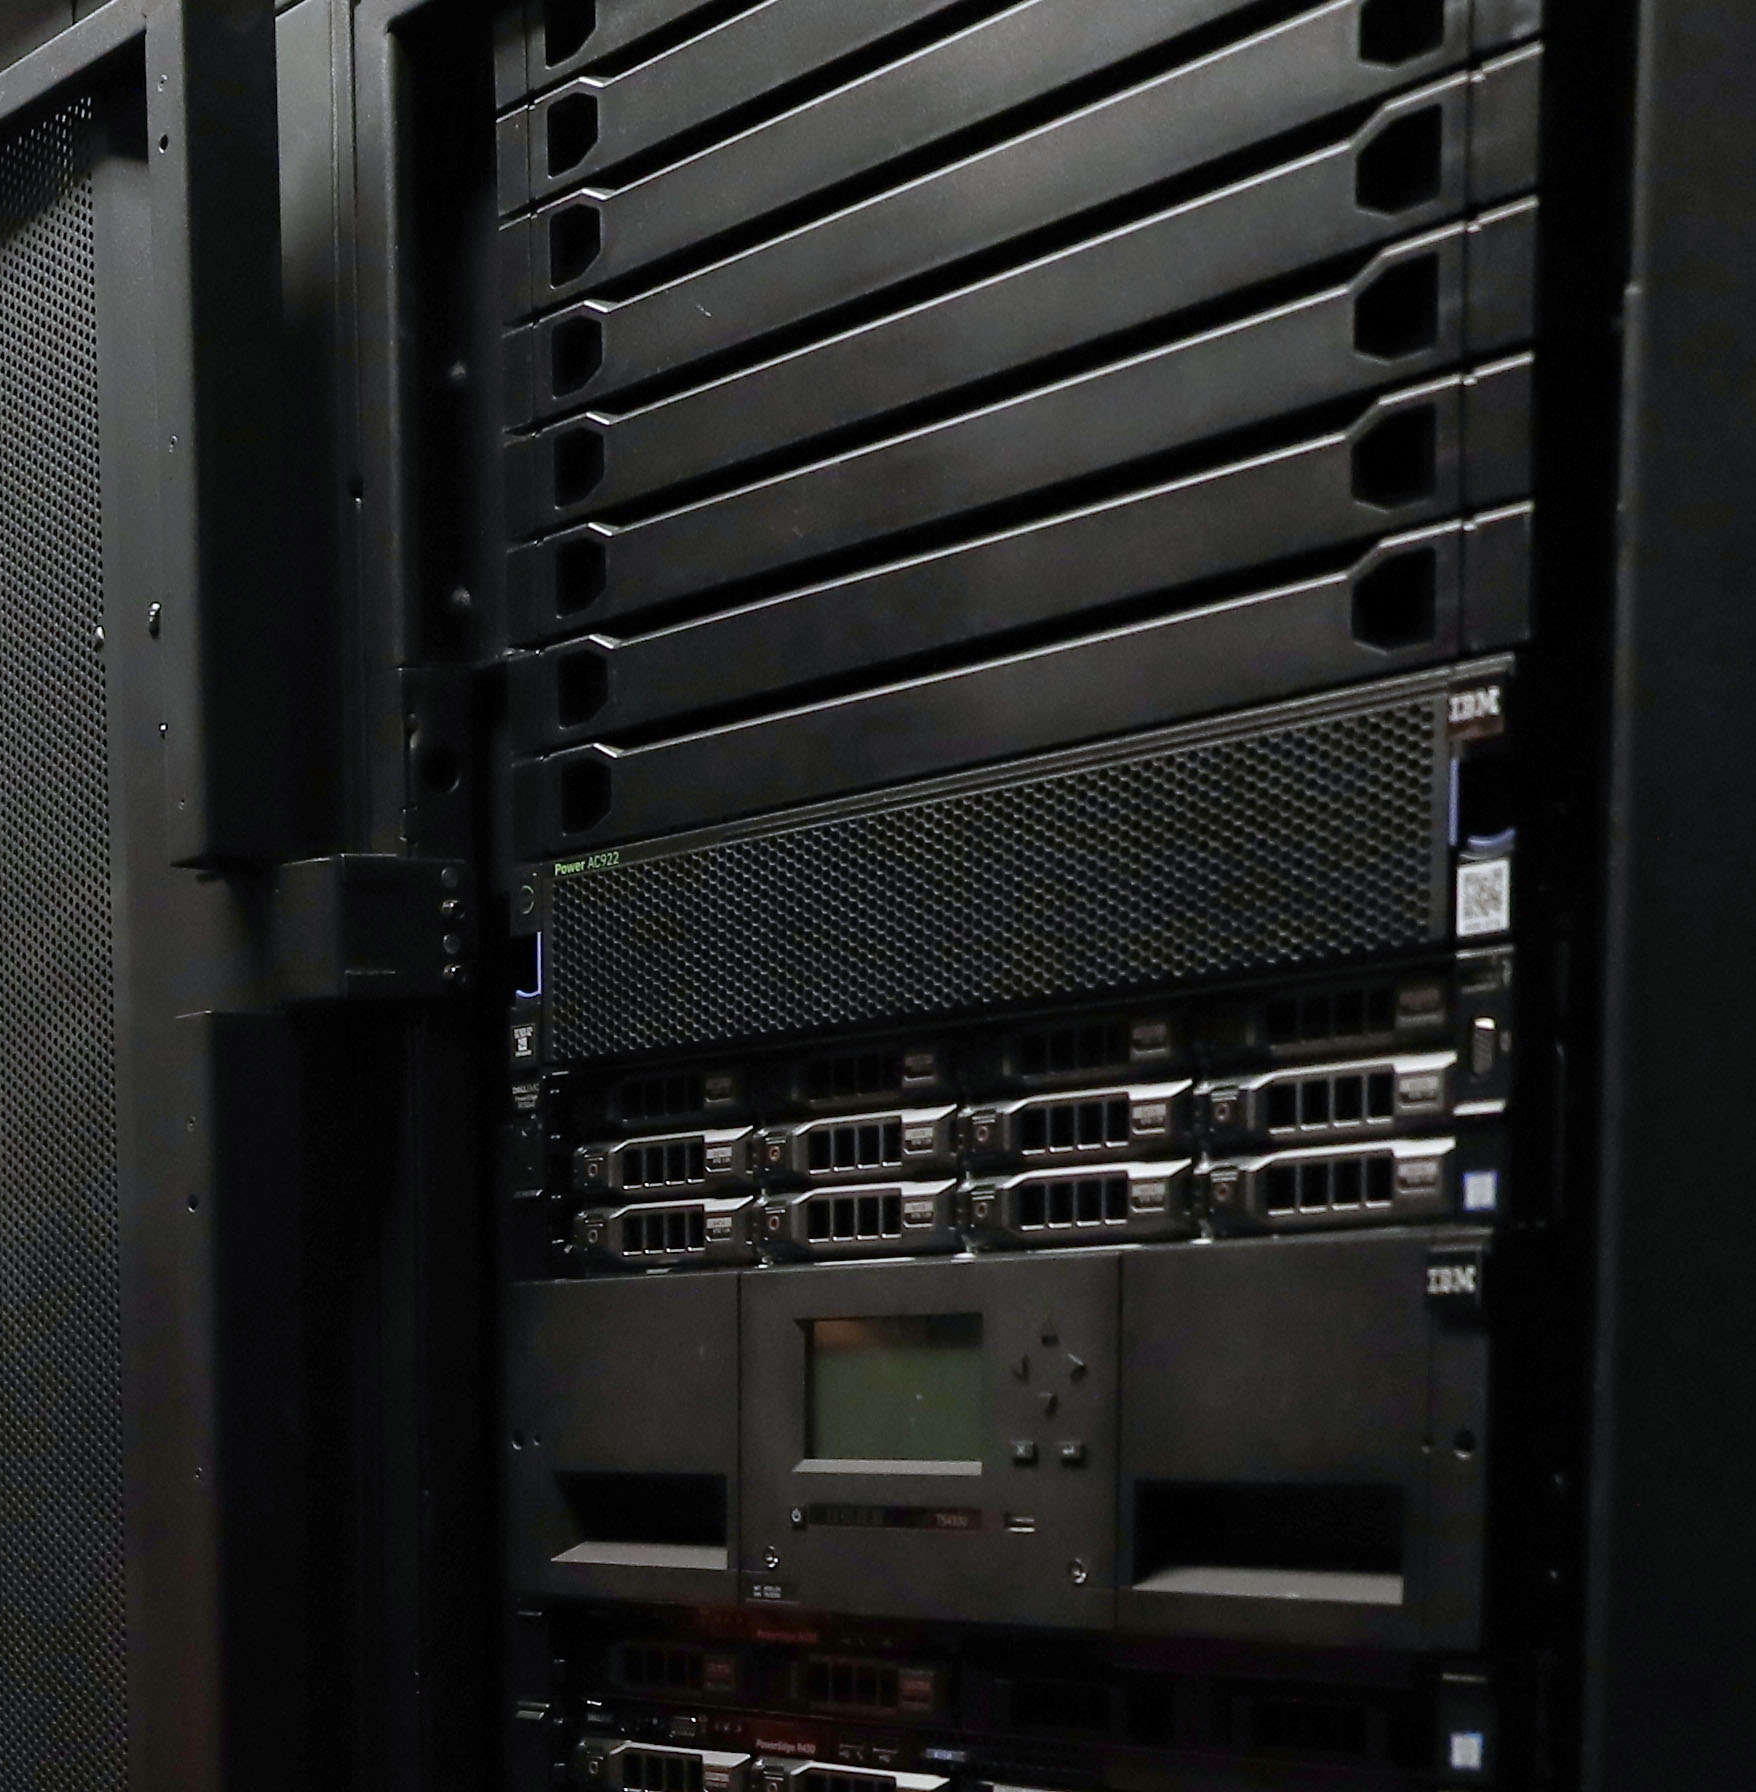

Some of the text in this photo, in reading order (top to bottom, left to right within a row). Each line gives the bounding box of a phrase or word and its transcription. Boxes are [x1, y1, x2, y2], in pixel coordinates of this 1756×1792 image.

[1448, 685, 1500, 722] IBM
[554, 851, 620, 877] Power AC922
[1425, 1264, 1478, 1295] IBM
[755, 1738, 795, 1752] PowerEdge
